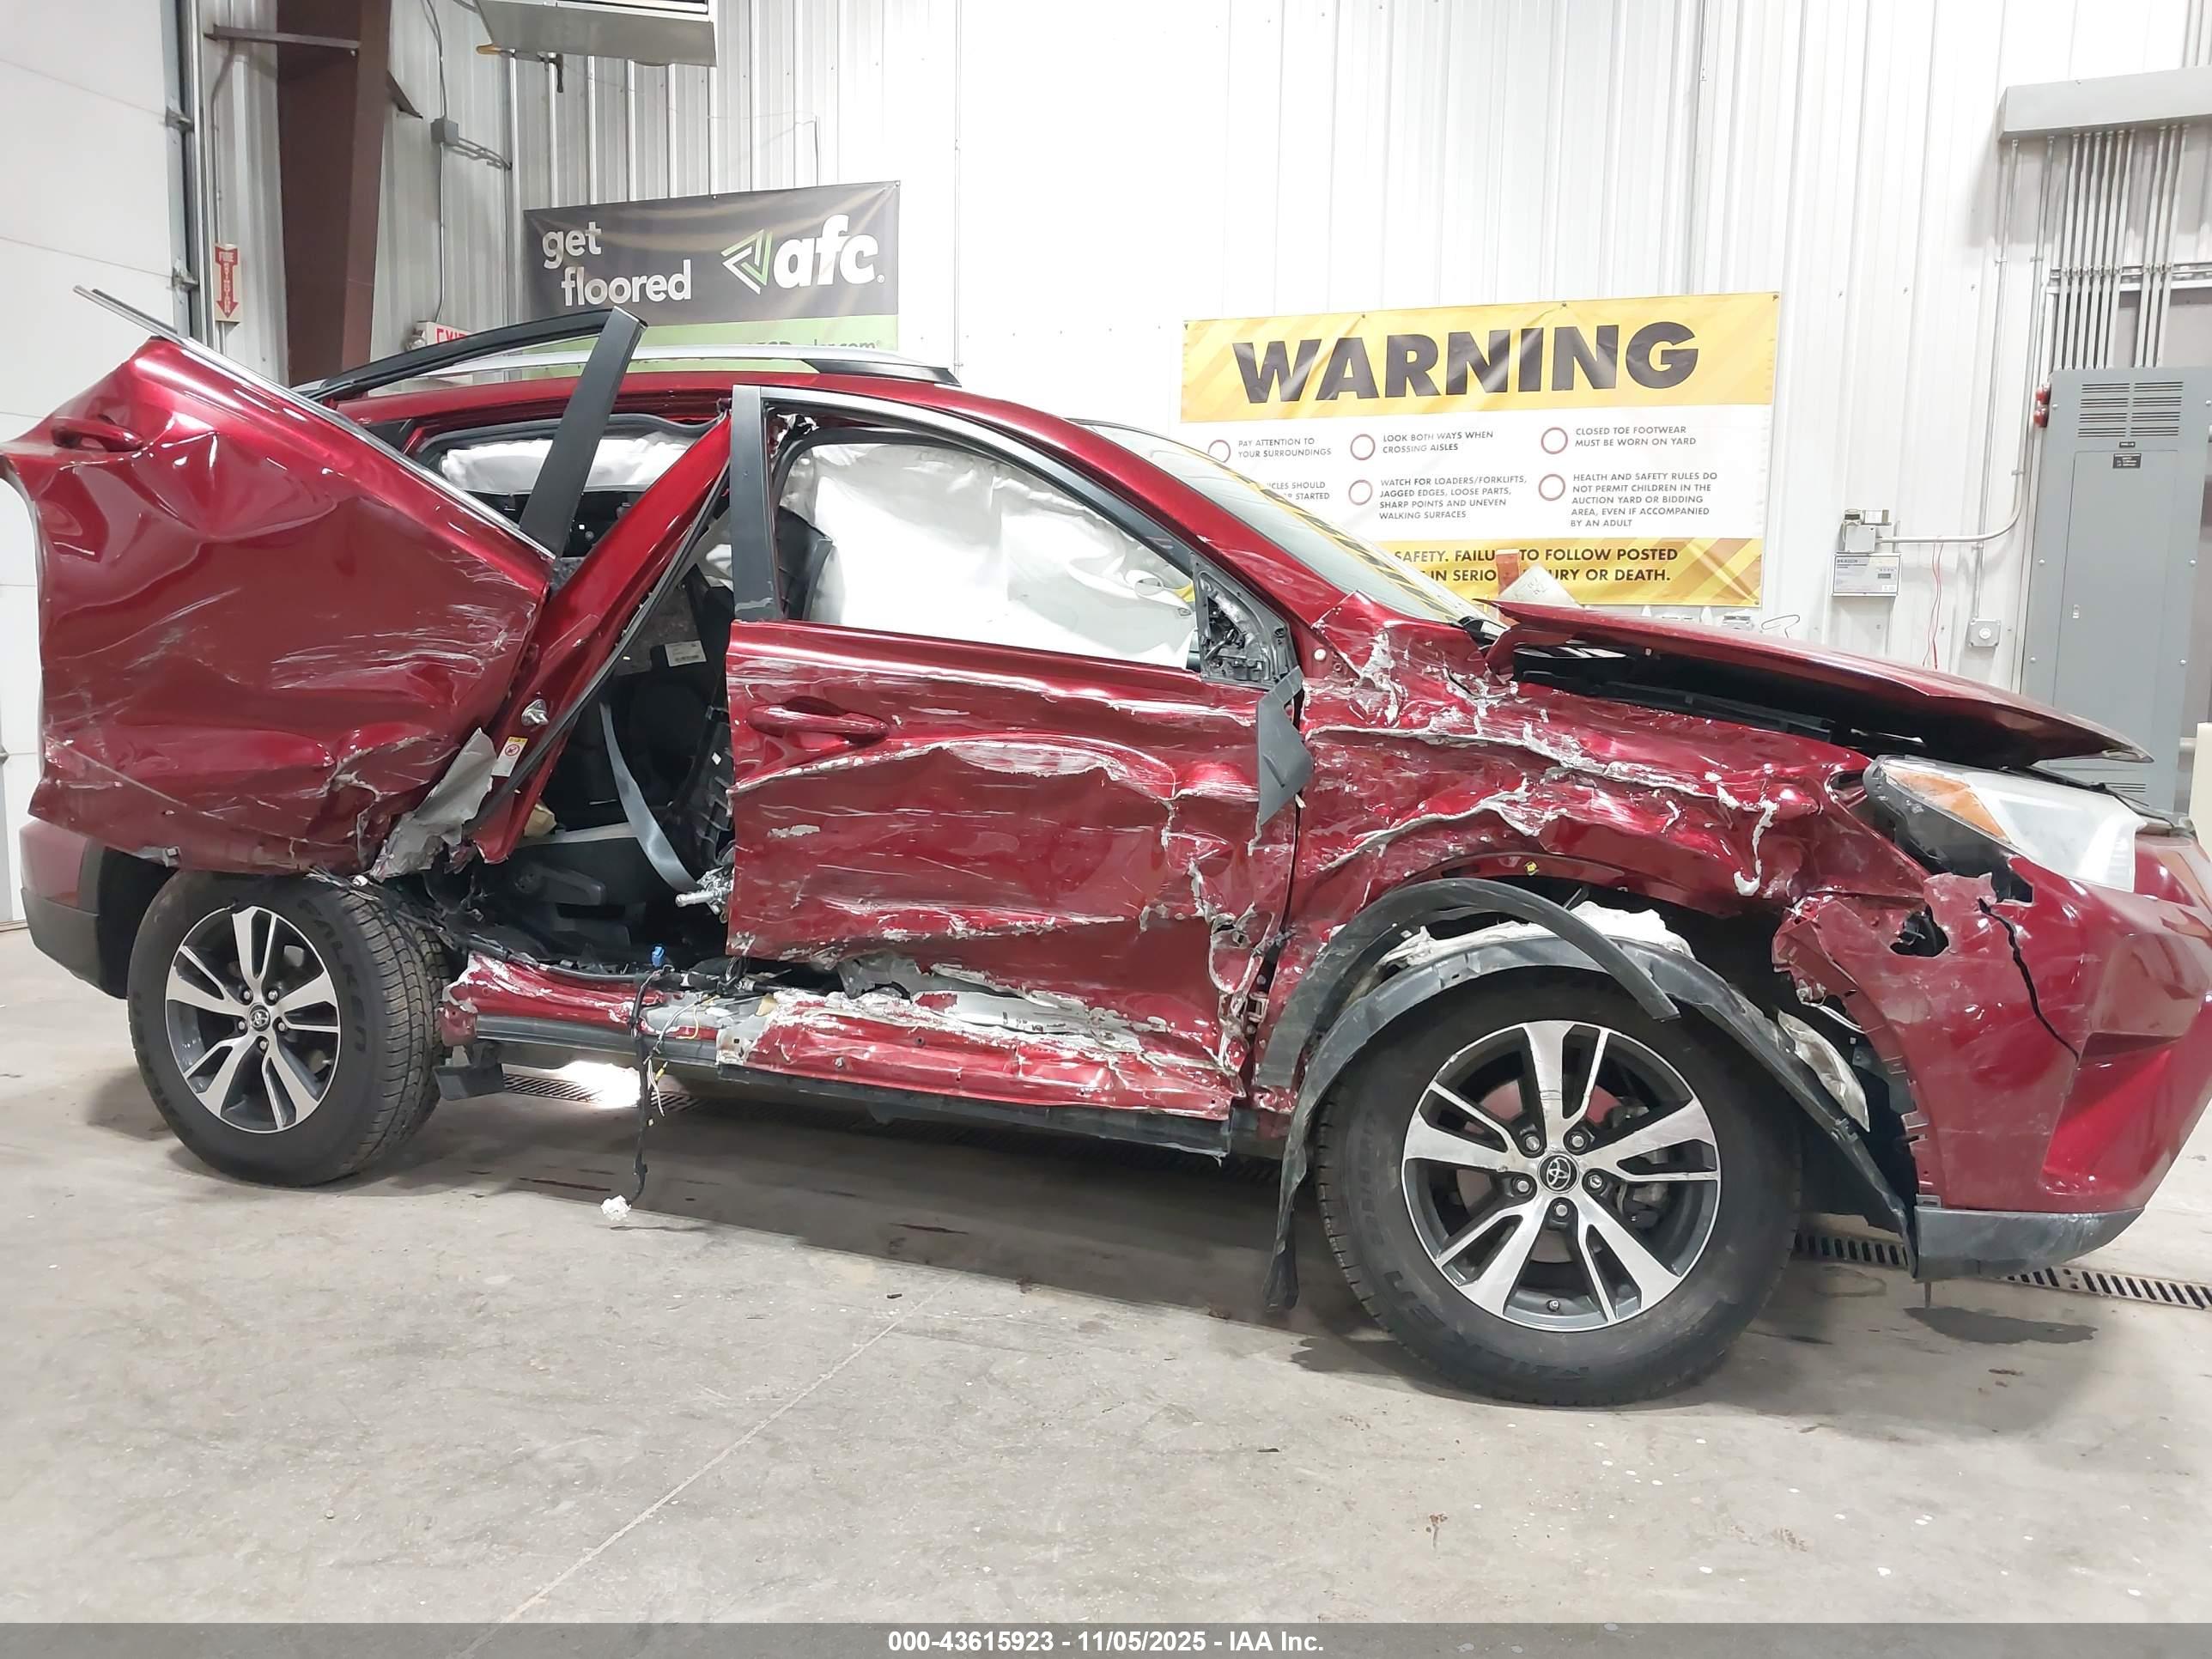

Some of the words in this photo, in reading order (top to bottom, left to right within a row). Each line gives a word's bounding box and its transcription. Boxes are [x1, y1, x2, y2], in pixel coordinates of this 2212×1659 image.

[542, 221, 602, 269] get
[561, 258, 692, 307] floored
[1232, 321, 1698, 404] WARNING
[1633, 426, 1686, 434] FOOTWEAR
[1255, 438, 1301, 447] ATTENTION
[1575, 439, 1601, 447] MUST
[1671, 437, 1696, 446] YARD
[1382, 445, 1427, 453] CROSSING
[1430, 443, 1459, 452] AISLES
[1238, 450, 1261, 459] YOUR
[1263, 448, 1332, 458] SURROUNDINGS
[1434, 475, 1527, 485] LOADERS/FORKLIFTS,
[1573, 473, 1607, 482] HEALTH
[1380, 489, 1415, 498] JAGGED
[1417, 489, 1448, 497] EDGES,
[1450, 488, 1480, 496] LOOSE
[1482, 487, 1511, 495] PARTS,
[1595, 484, 1628, 493] PERMIT
[1379, 501, 1408, 509] SHARP
[1412, 500, 1443, 508] POINTS
[1469, 498, 1506, 507] UNEVEN
[1424, 511, 1467, 520] SURFACES
[1639, 507, 1710, 515] ACCOMPANIED
[1602, 519, 1632, 527] ADULT
[1394, 550, 1449, 562] SAFETY.
[1455, 550, 1496, 562] FAILU
[1519, 550, 1539, 561] TO
[1545, 549, 1612, 561] FOLLOW
[1617, 549, 1678, 561] POSTED
[1453, 569, 1497, 581] SERIO
[1585, 568, 1608, 581] OR
[1614, 569, 1671, 581] DEATH.
